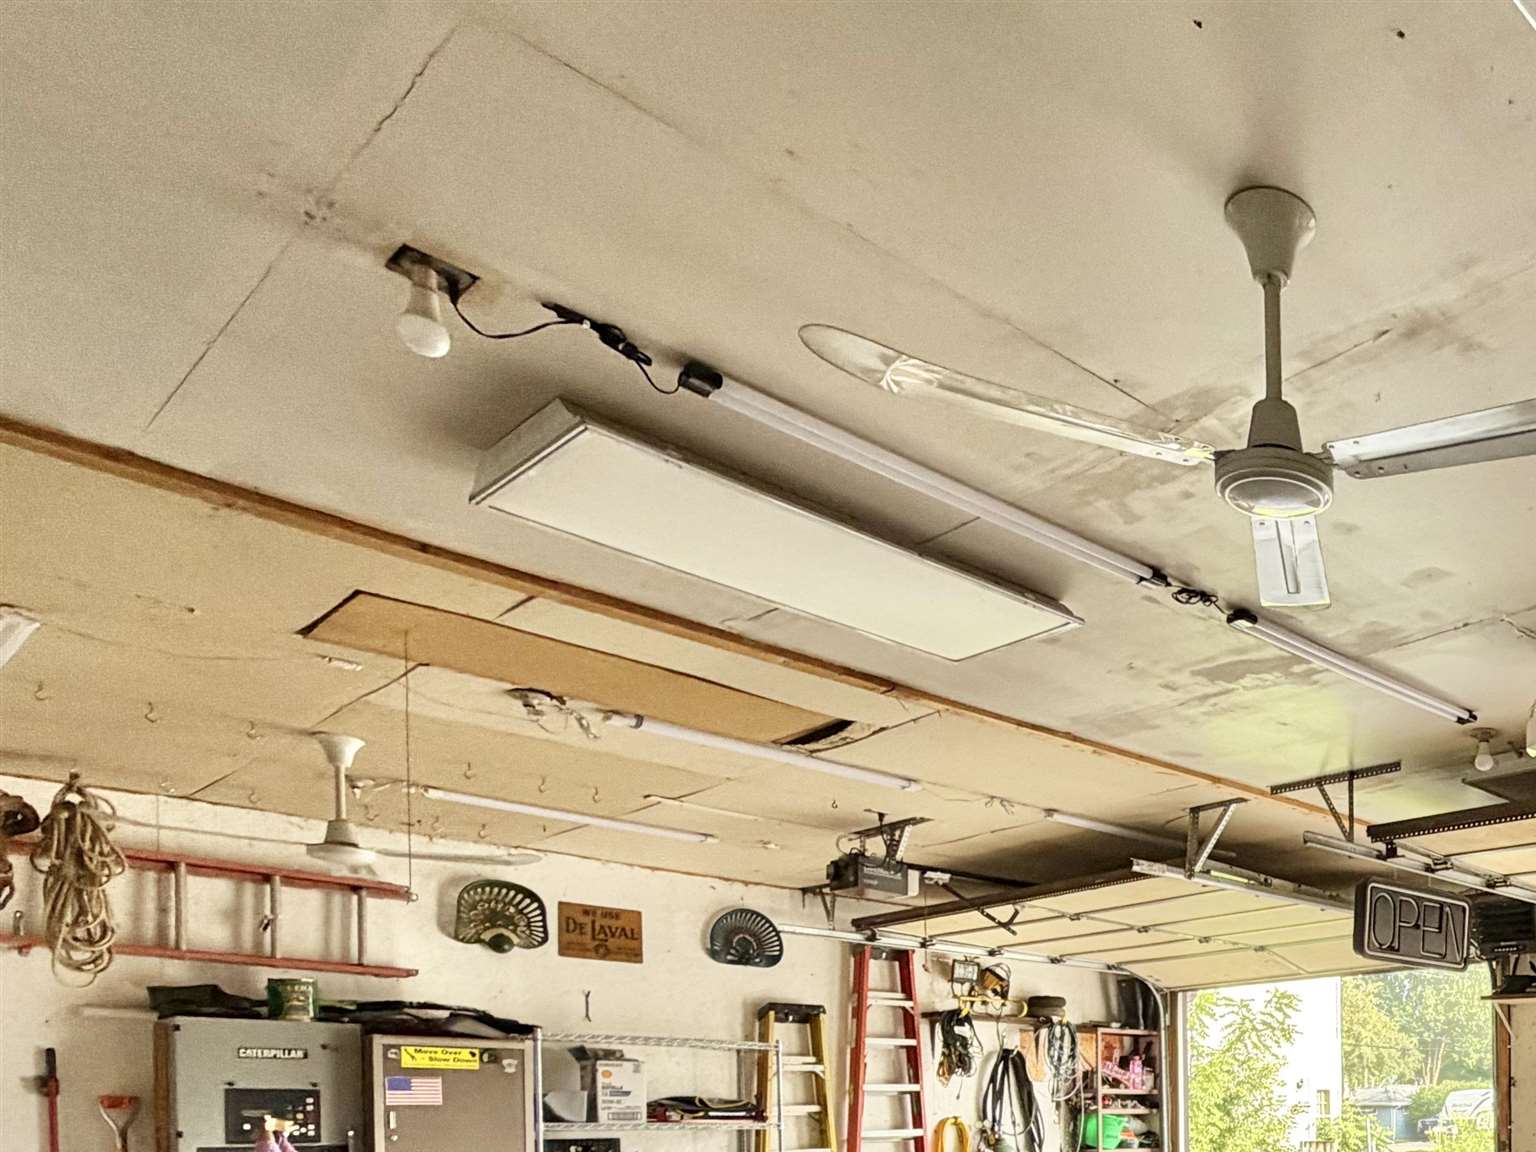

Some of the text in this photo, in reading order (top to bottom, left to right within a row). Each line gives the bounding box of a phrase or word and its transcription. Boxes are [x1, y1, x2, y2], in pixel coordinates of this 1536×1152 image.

[1372, 892, 1463, 962] OPEN
[238, 1047, 304, 1059] CATERPILLAR
[441, 1048, 462, 1056] Over
